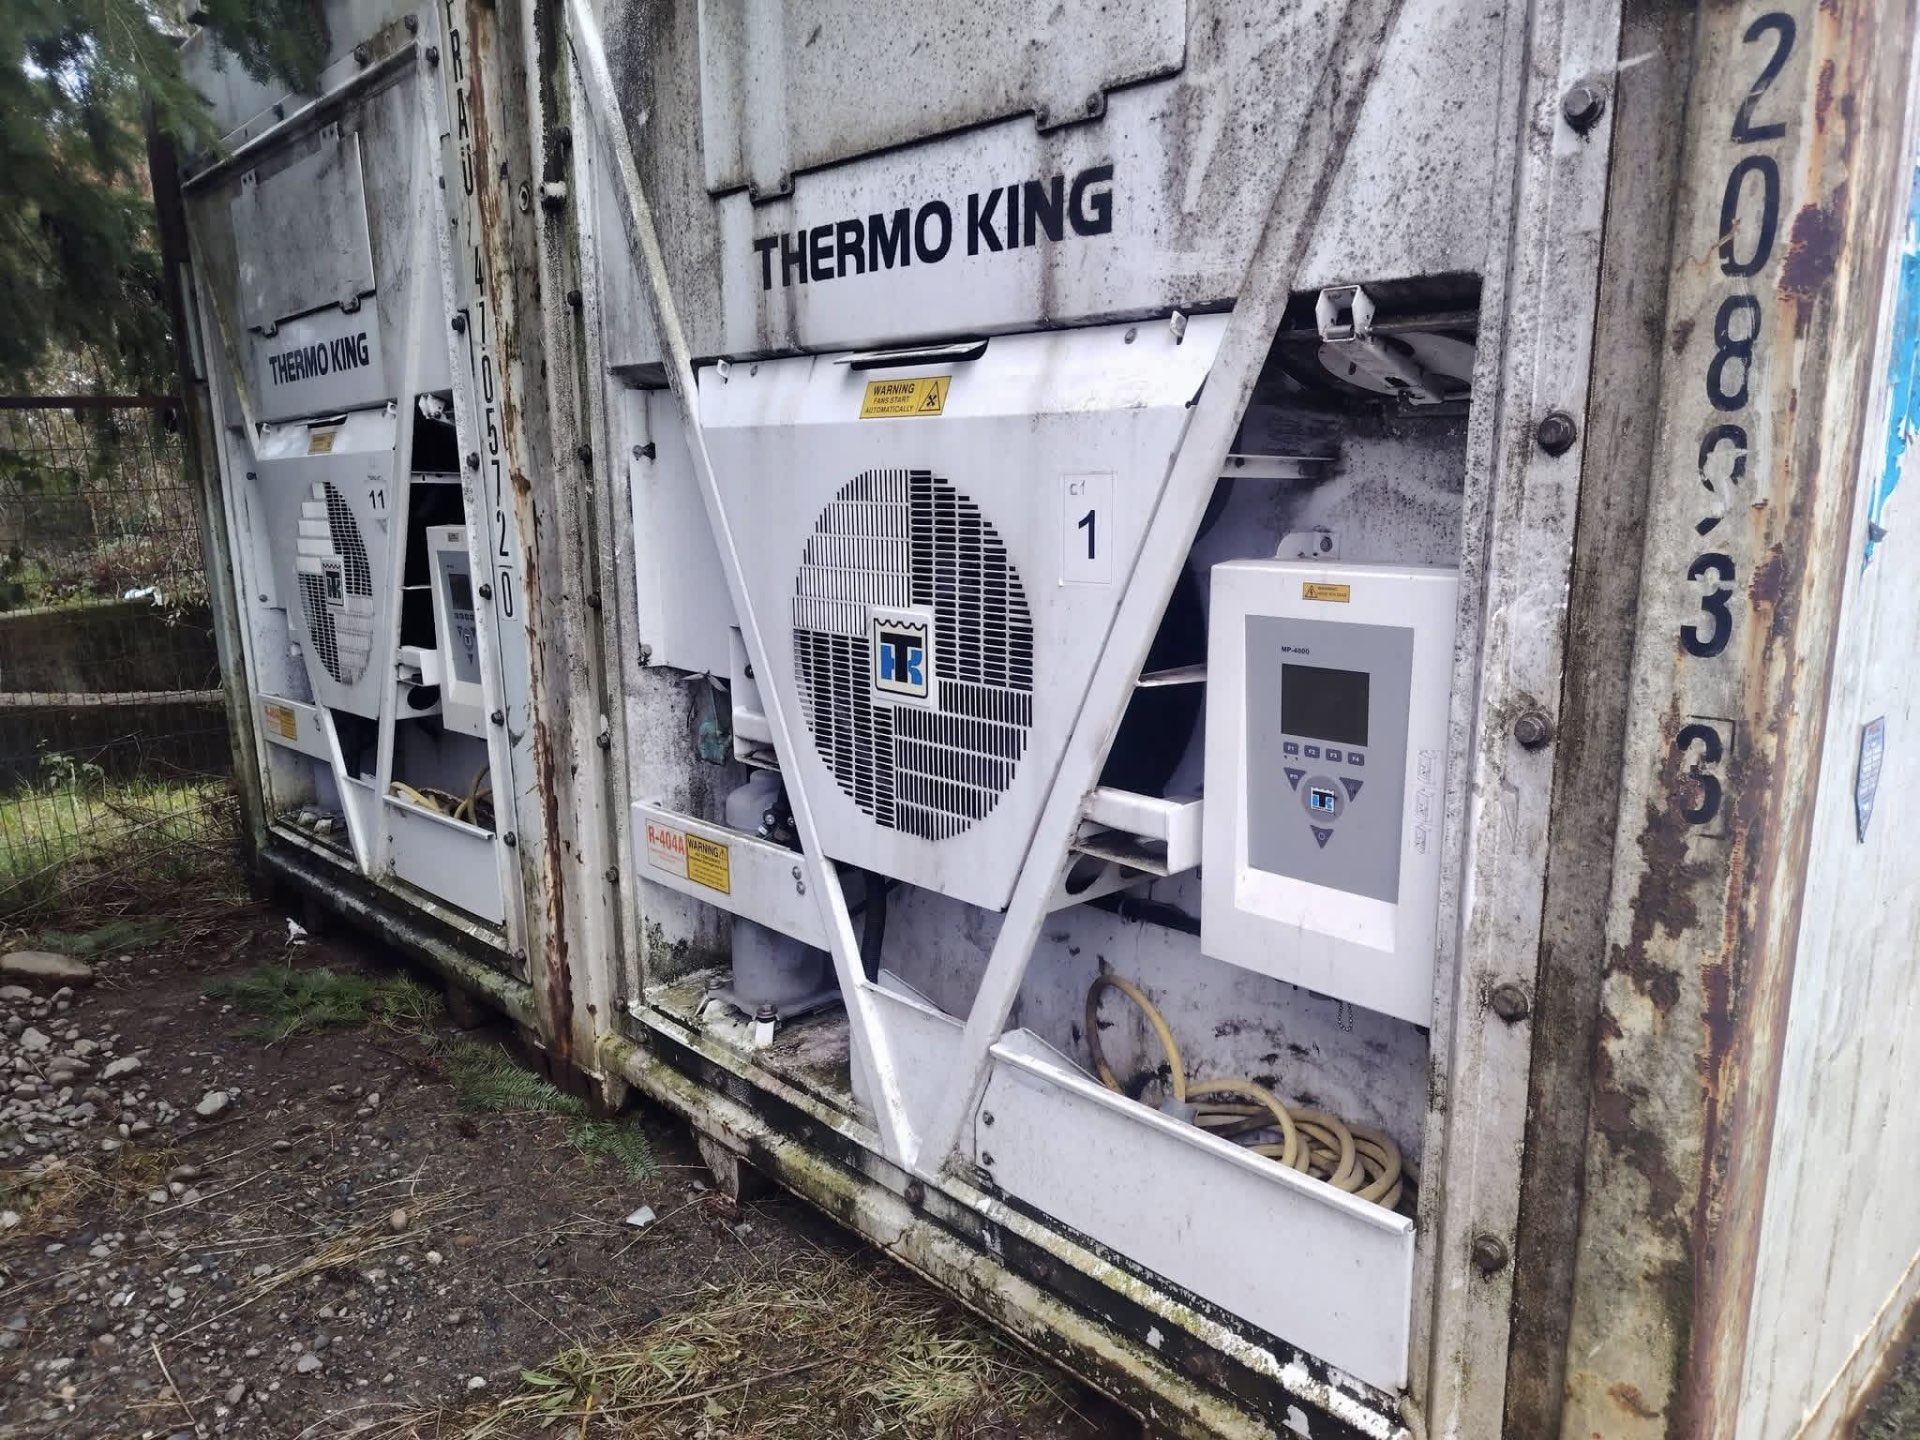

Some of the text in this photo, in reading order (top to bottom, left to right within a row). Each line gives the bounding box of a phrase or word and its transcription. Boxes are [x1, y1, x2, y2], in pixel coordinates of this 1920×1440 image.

[753, 164, 1114, 290] THERMO KING
[268, 332, 370, 386] THERMO KING
[873, 383, 915, 396] WARNING
[873, 395, 910, 405] FANS START
[865, 404, 915, 414] AUTOMATICALLY
[368, 489, 385, 510] 11
[1078, 509, 1096, 560] 1
[647, 824, 686, 856] R-404A
[687, 838, 719, 858] WARNING
